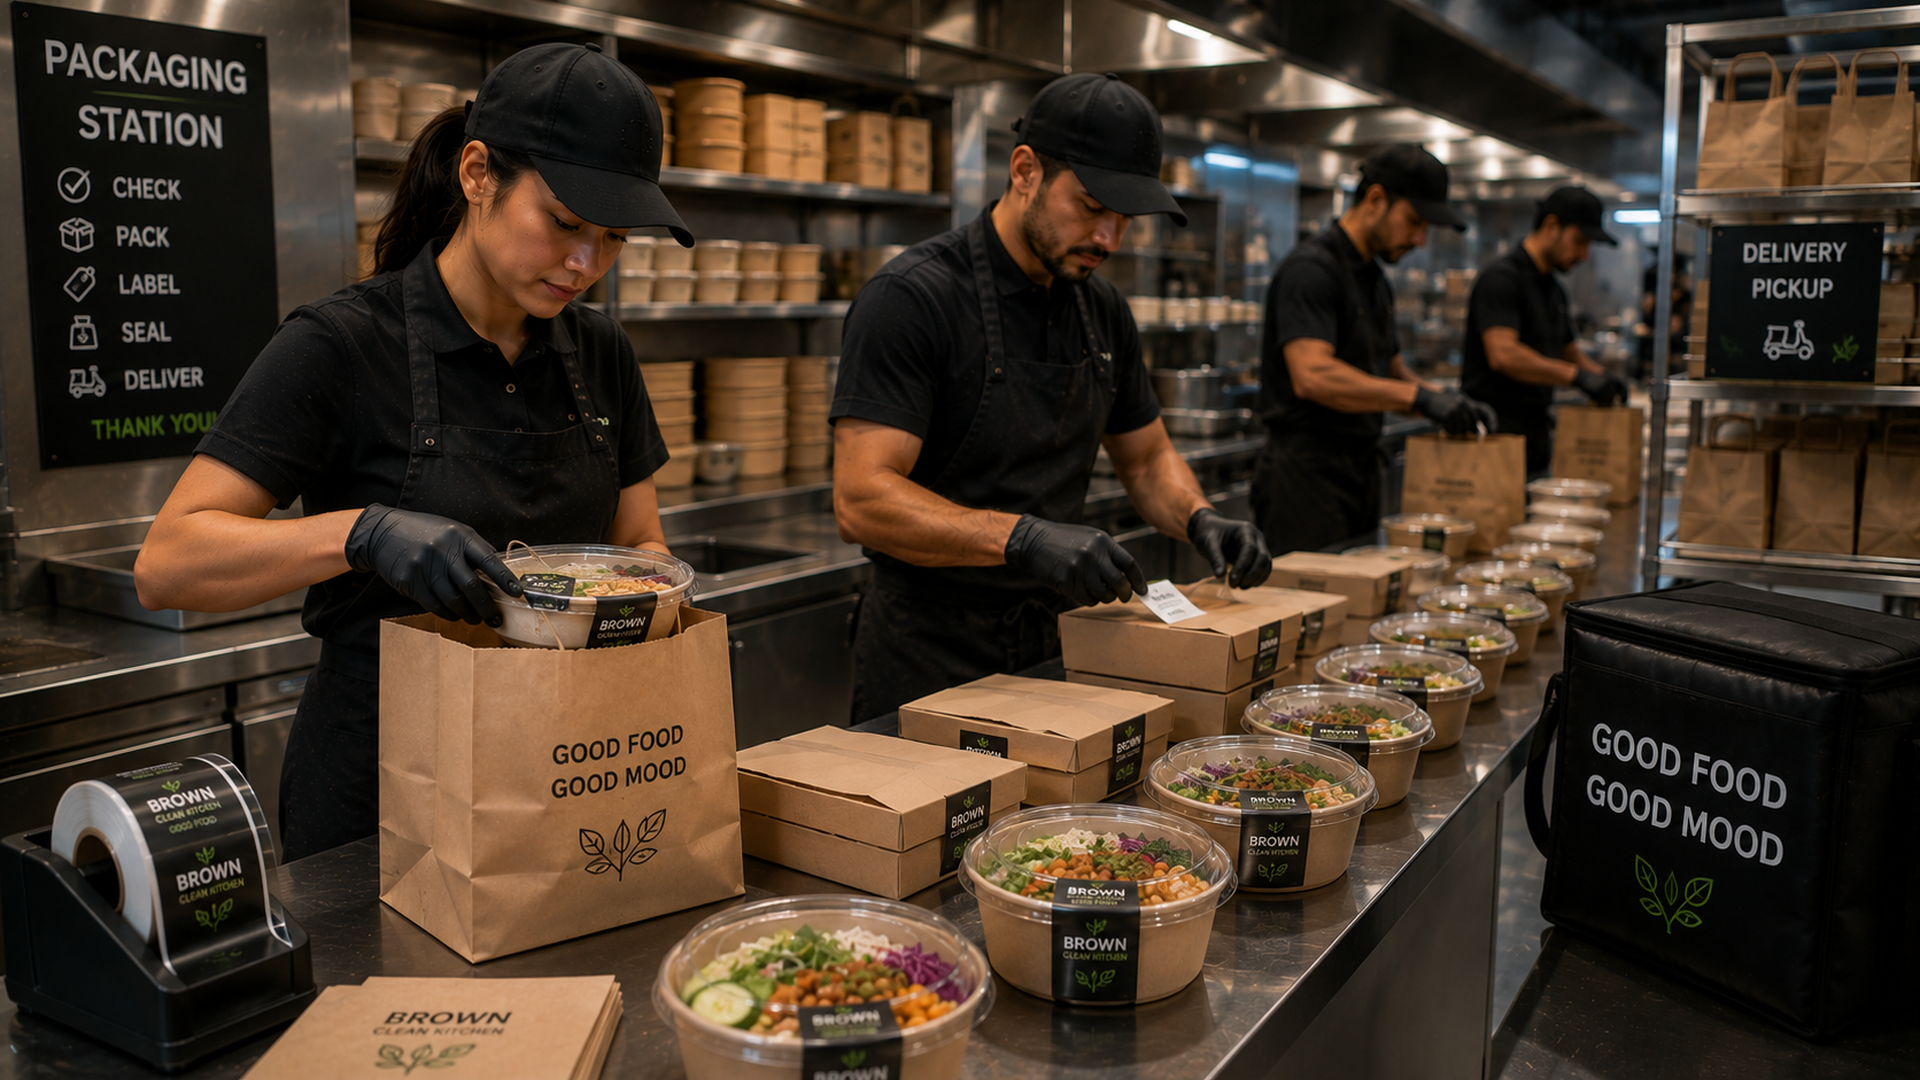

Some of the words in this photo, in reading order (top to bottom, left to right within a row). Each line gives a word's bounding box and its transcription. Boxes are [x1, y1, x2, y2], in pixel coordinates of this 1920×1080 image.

[44, 39, 248, 95] PACKAGING
[78, 104, 224, 150] STATION
[112, 176, 182, 200] CHECK
[116, 225, 170, 248] PACK
[1743, 242, 1847, 263] DELIVERY
[119, 273, 181, 295] LABEL
[1752, 278, 1834, 299] PICKUP
[121, 321, 172, 343] SEAL
[124, 366, 204, 391] DELIVER
[91, 414, 165, 440] THANK
[599, 616, 646, 630] BROWN
[552, 738, 620, 765] GOOD
[628, 725, 683, 754] FOOD
[1592, 723, 1681, 776] GOOD
[1691, 752, 1787, 809] FOOD
[551, 771, 618, 799] GOOD
[625, 756, 686, 787] MOOD
[147, 786, 216, 813] BROWN
[951, 805, 985, 828] BROWN
[1586, 774, 1672, 829] GOOD
[1681, 805, 1784, 867] MOOD
[1249, 835, 1300, 847] BROWN
[176, 858, 242, 892] BROWN
[179, 887, 208, 904] CLEAN
[1067, 886, 1125, 897] BROWN
[1063, 936, 1127, 951] BROWN
[1063, 951, 1091, 961] CLEAN
[384, 1011, 512, 1025] BROWN
[811, 1010, 881, 1026] BROWN
[373, 1026, 429, 1036] CLEAN
[433, 1027, 505, 1036] KITCHEN
